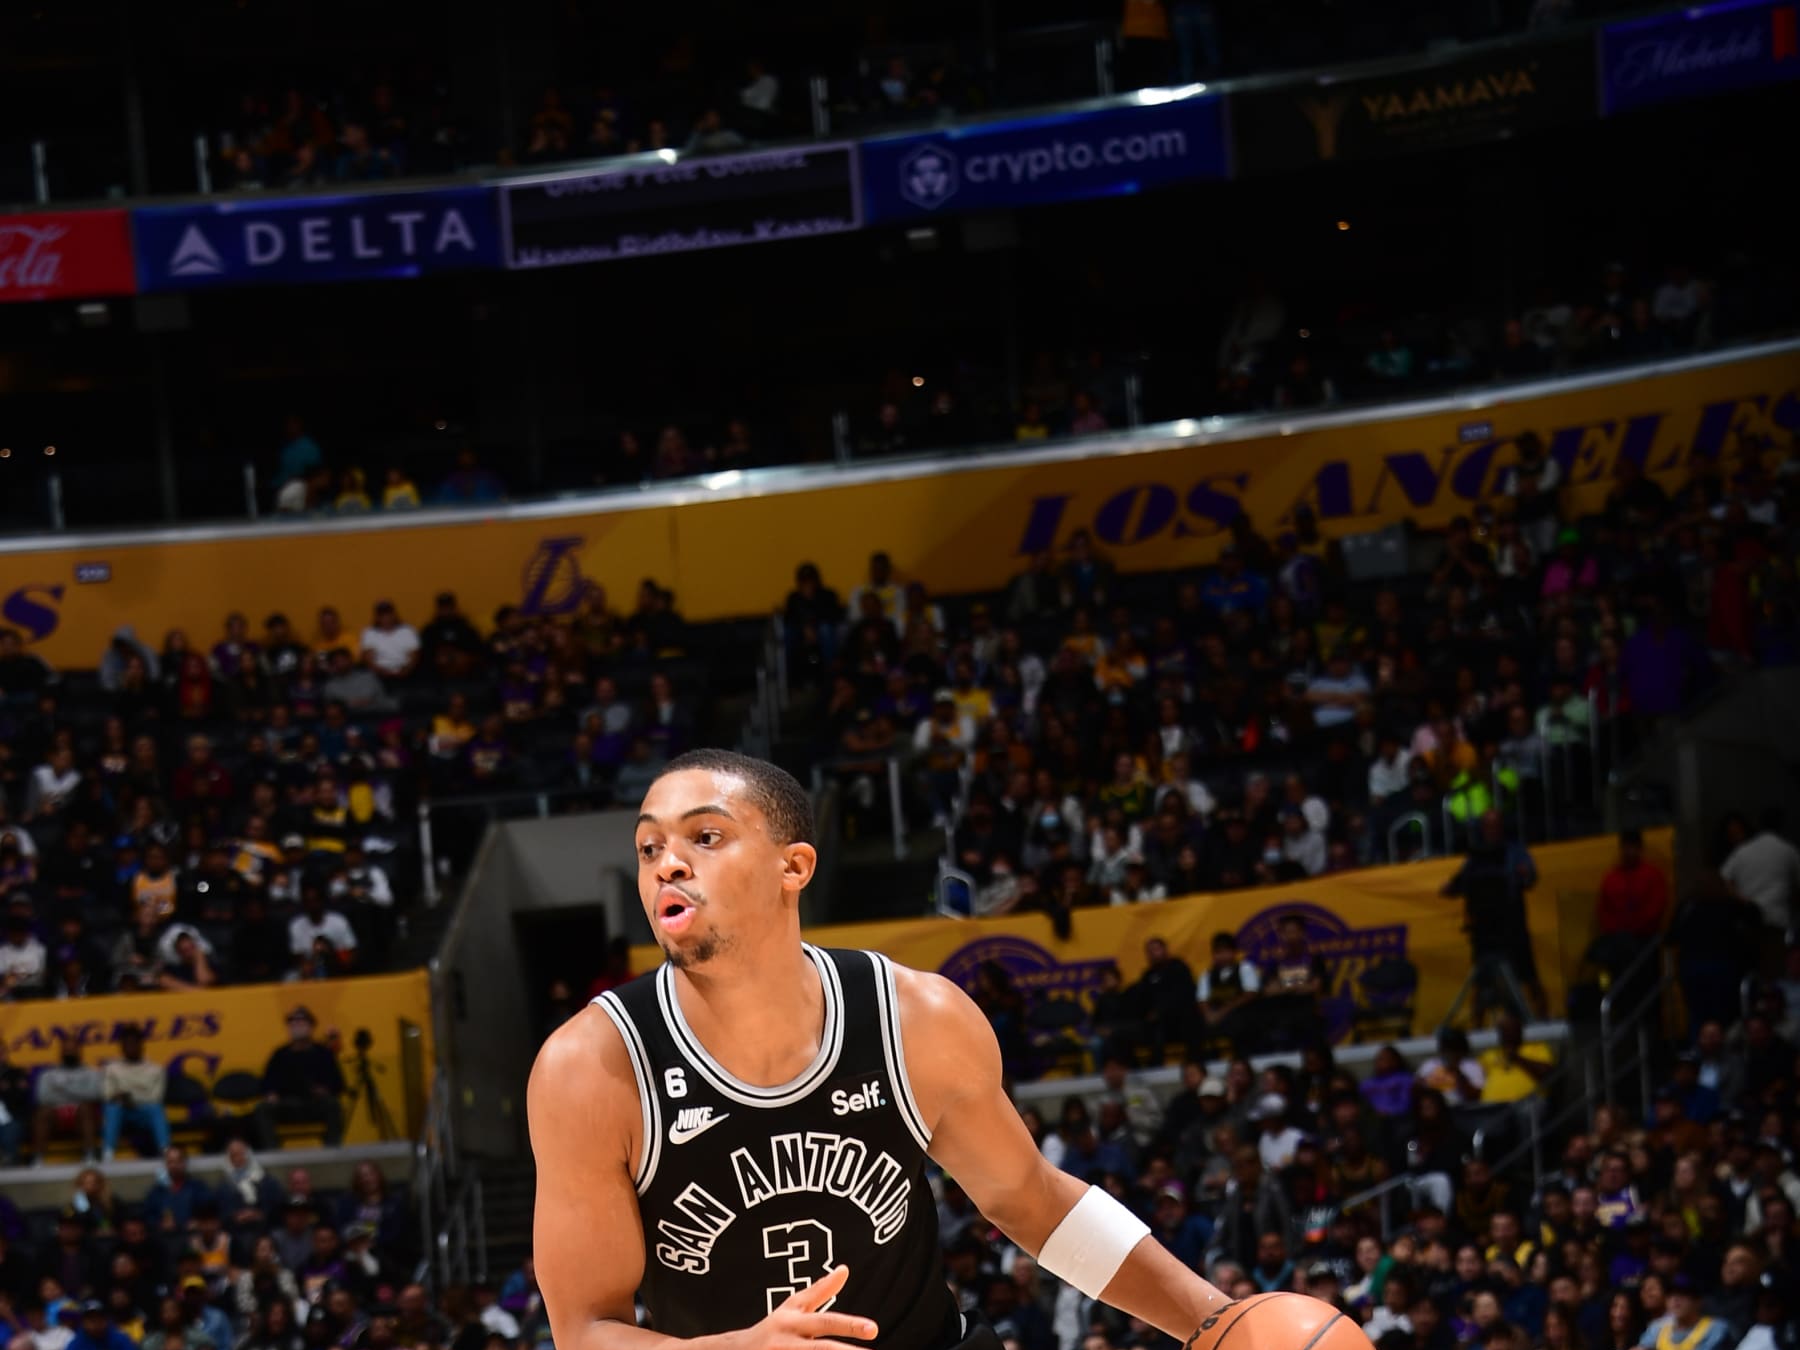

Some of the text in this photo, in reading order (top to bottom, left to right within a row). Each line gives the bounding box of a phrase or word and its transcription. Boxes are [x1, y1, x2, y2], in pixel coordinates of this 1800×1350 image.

[964, 128, 1187, 185] crypto.com
[243, 207, 477, 266] DELTA
[1017, 474, 1251, 556] LOS
[664, 1067, 688, 1098] 6
[831, 1080, 886, 1115] Self.
[677, 1106, 713, 1130] NIKE
[656, 1131, 911, 1274] SAN ANTONIO
[763, 1219, 837, 1316] 3
